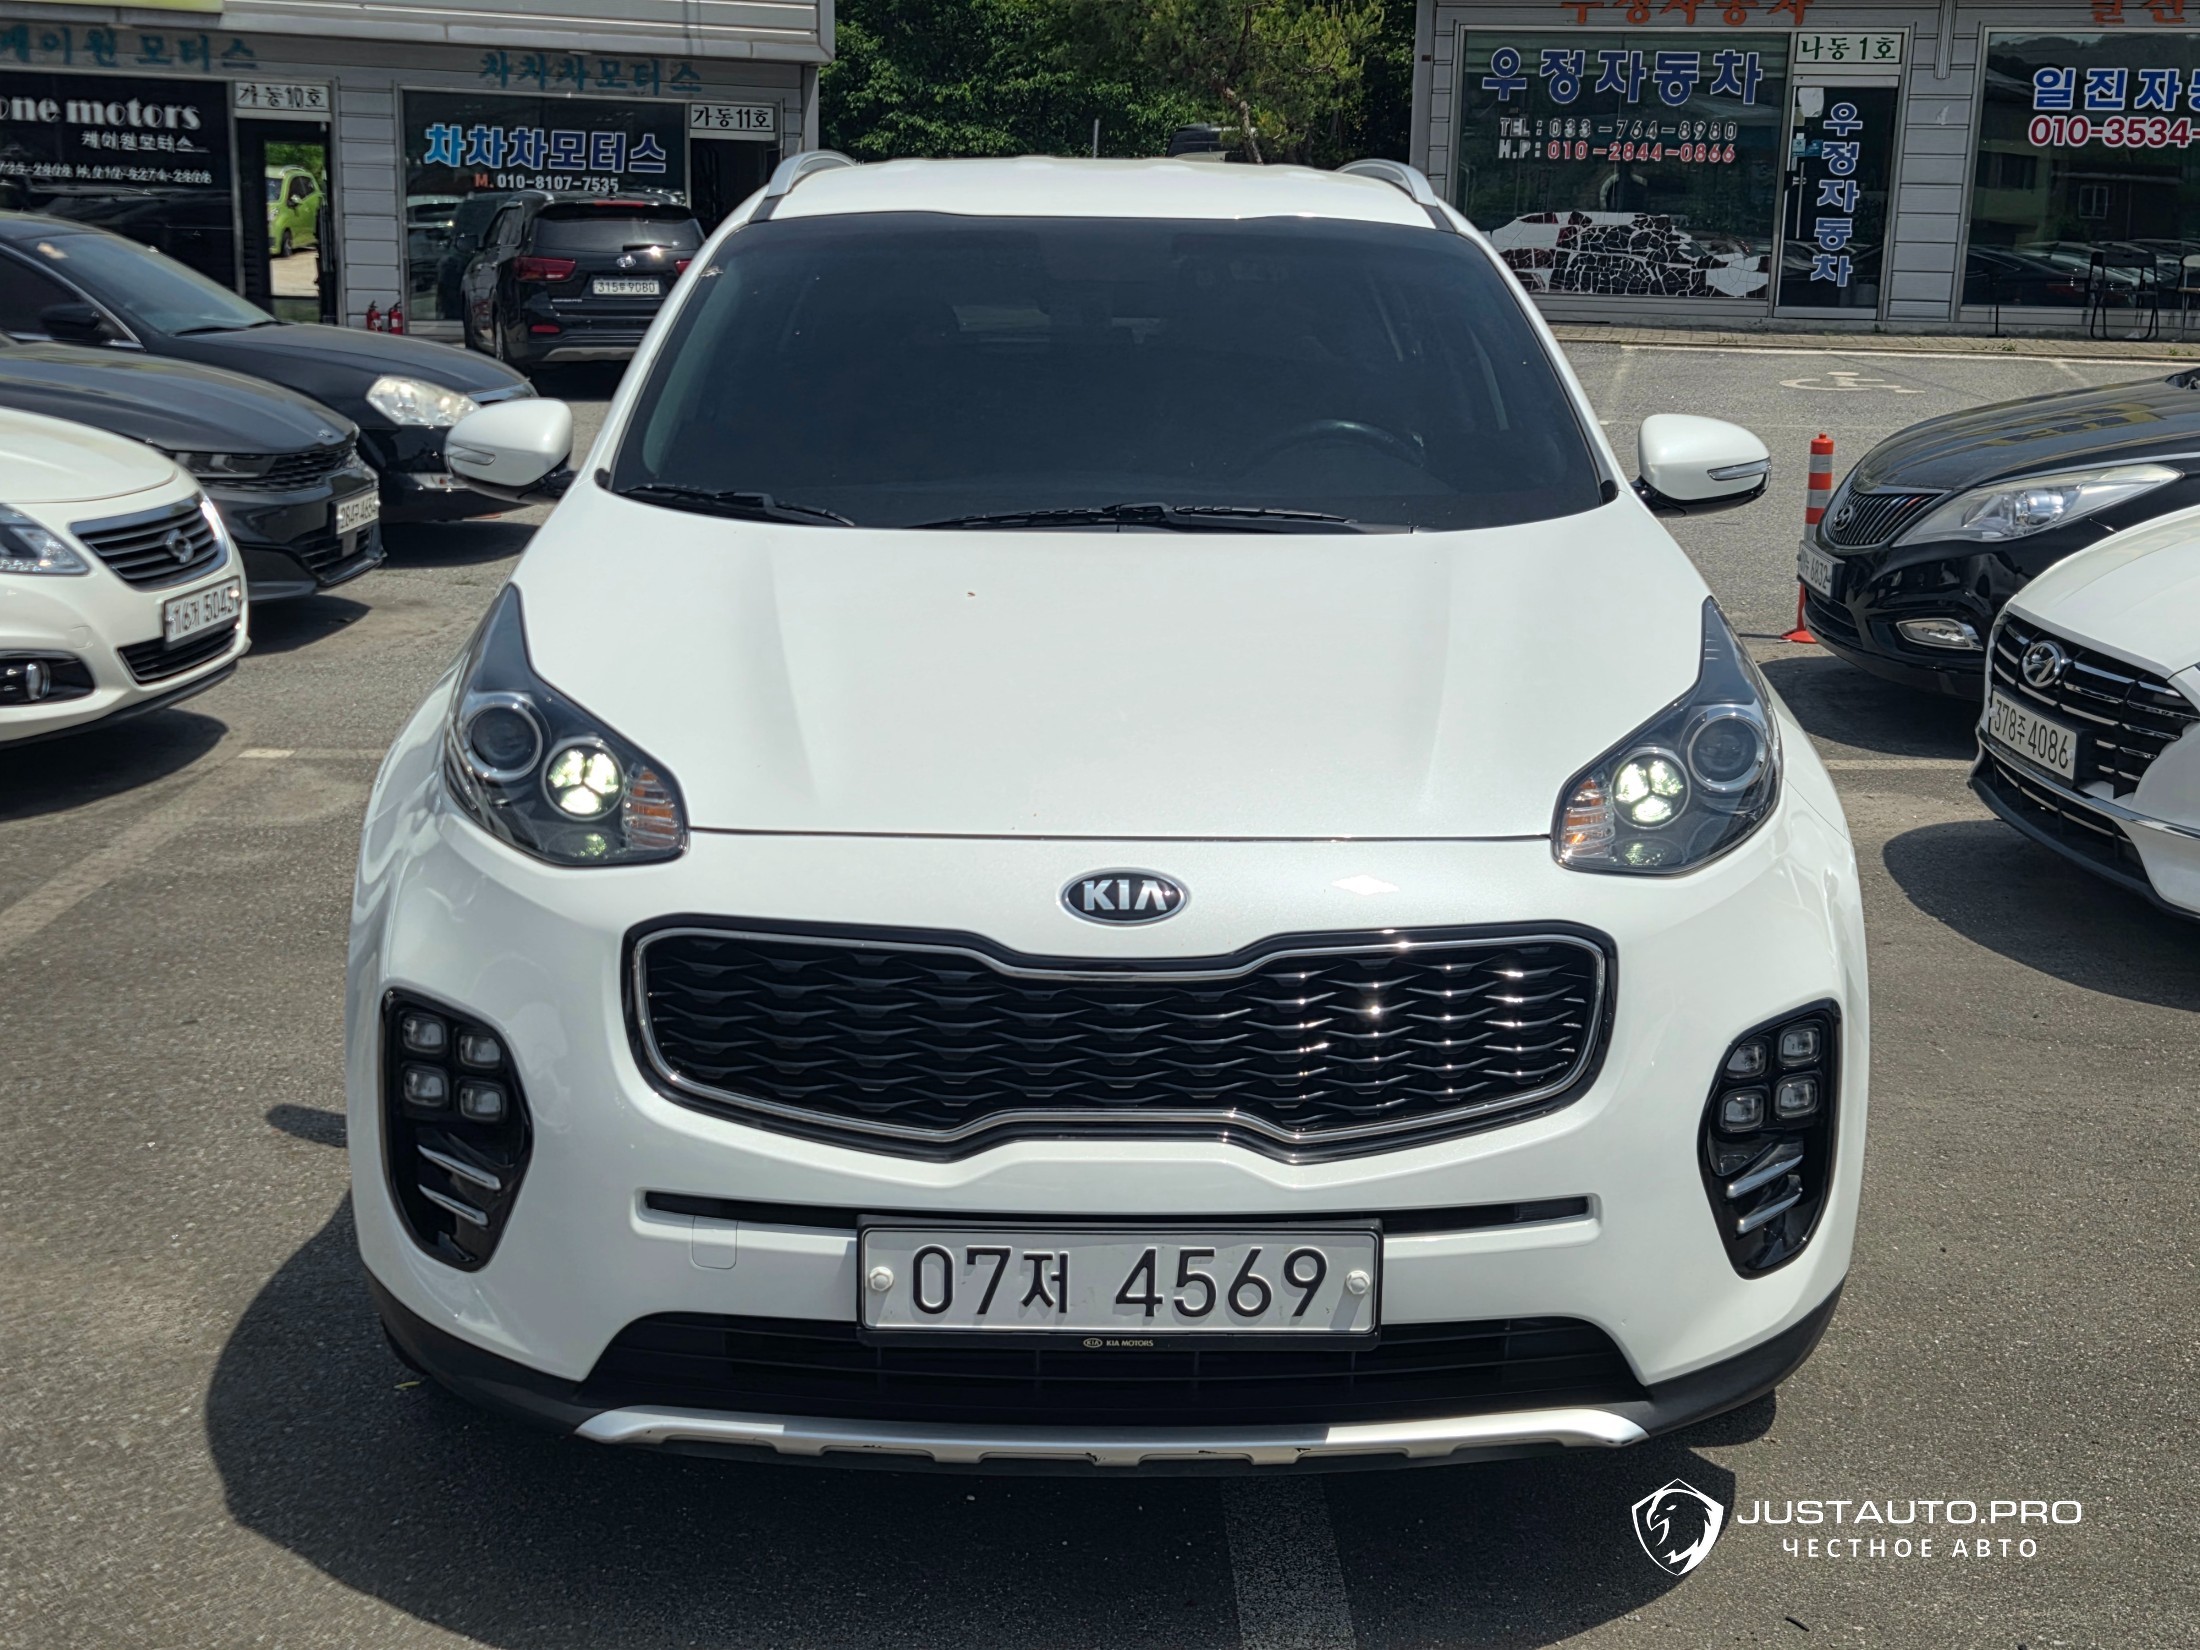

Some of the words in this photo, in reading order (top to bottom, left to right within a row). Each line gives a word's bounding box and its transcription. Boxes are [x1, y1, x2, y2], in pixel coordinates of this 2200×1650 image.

[1482, 47, 1763, 105] 우정자동차
[66, 98, 201, 130] motors
[693, 106, 771, 129] 가동11호
[424, 122, 667, 173] 차차차모터스
[1547, 140, 1736, 163] 010-2844-0866
[497, 174, 619, 192] 010-8107-7535
[1810, 102, 1863, 288] 우정자동차
[1994, 699, 2026, 745] 378주
[2028, 720, 2069, 769] 4086
[1082, 879, 1168, 911] KIA
[912, 1244, 1070, 1316] 07저
[1115, 1245, 1329, 1318] 4569
[1106, 1339, 1120, 1347] KIA
[1121, 1339, 1154, 1347] MOTORS
